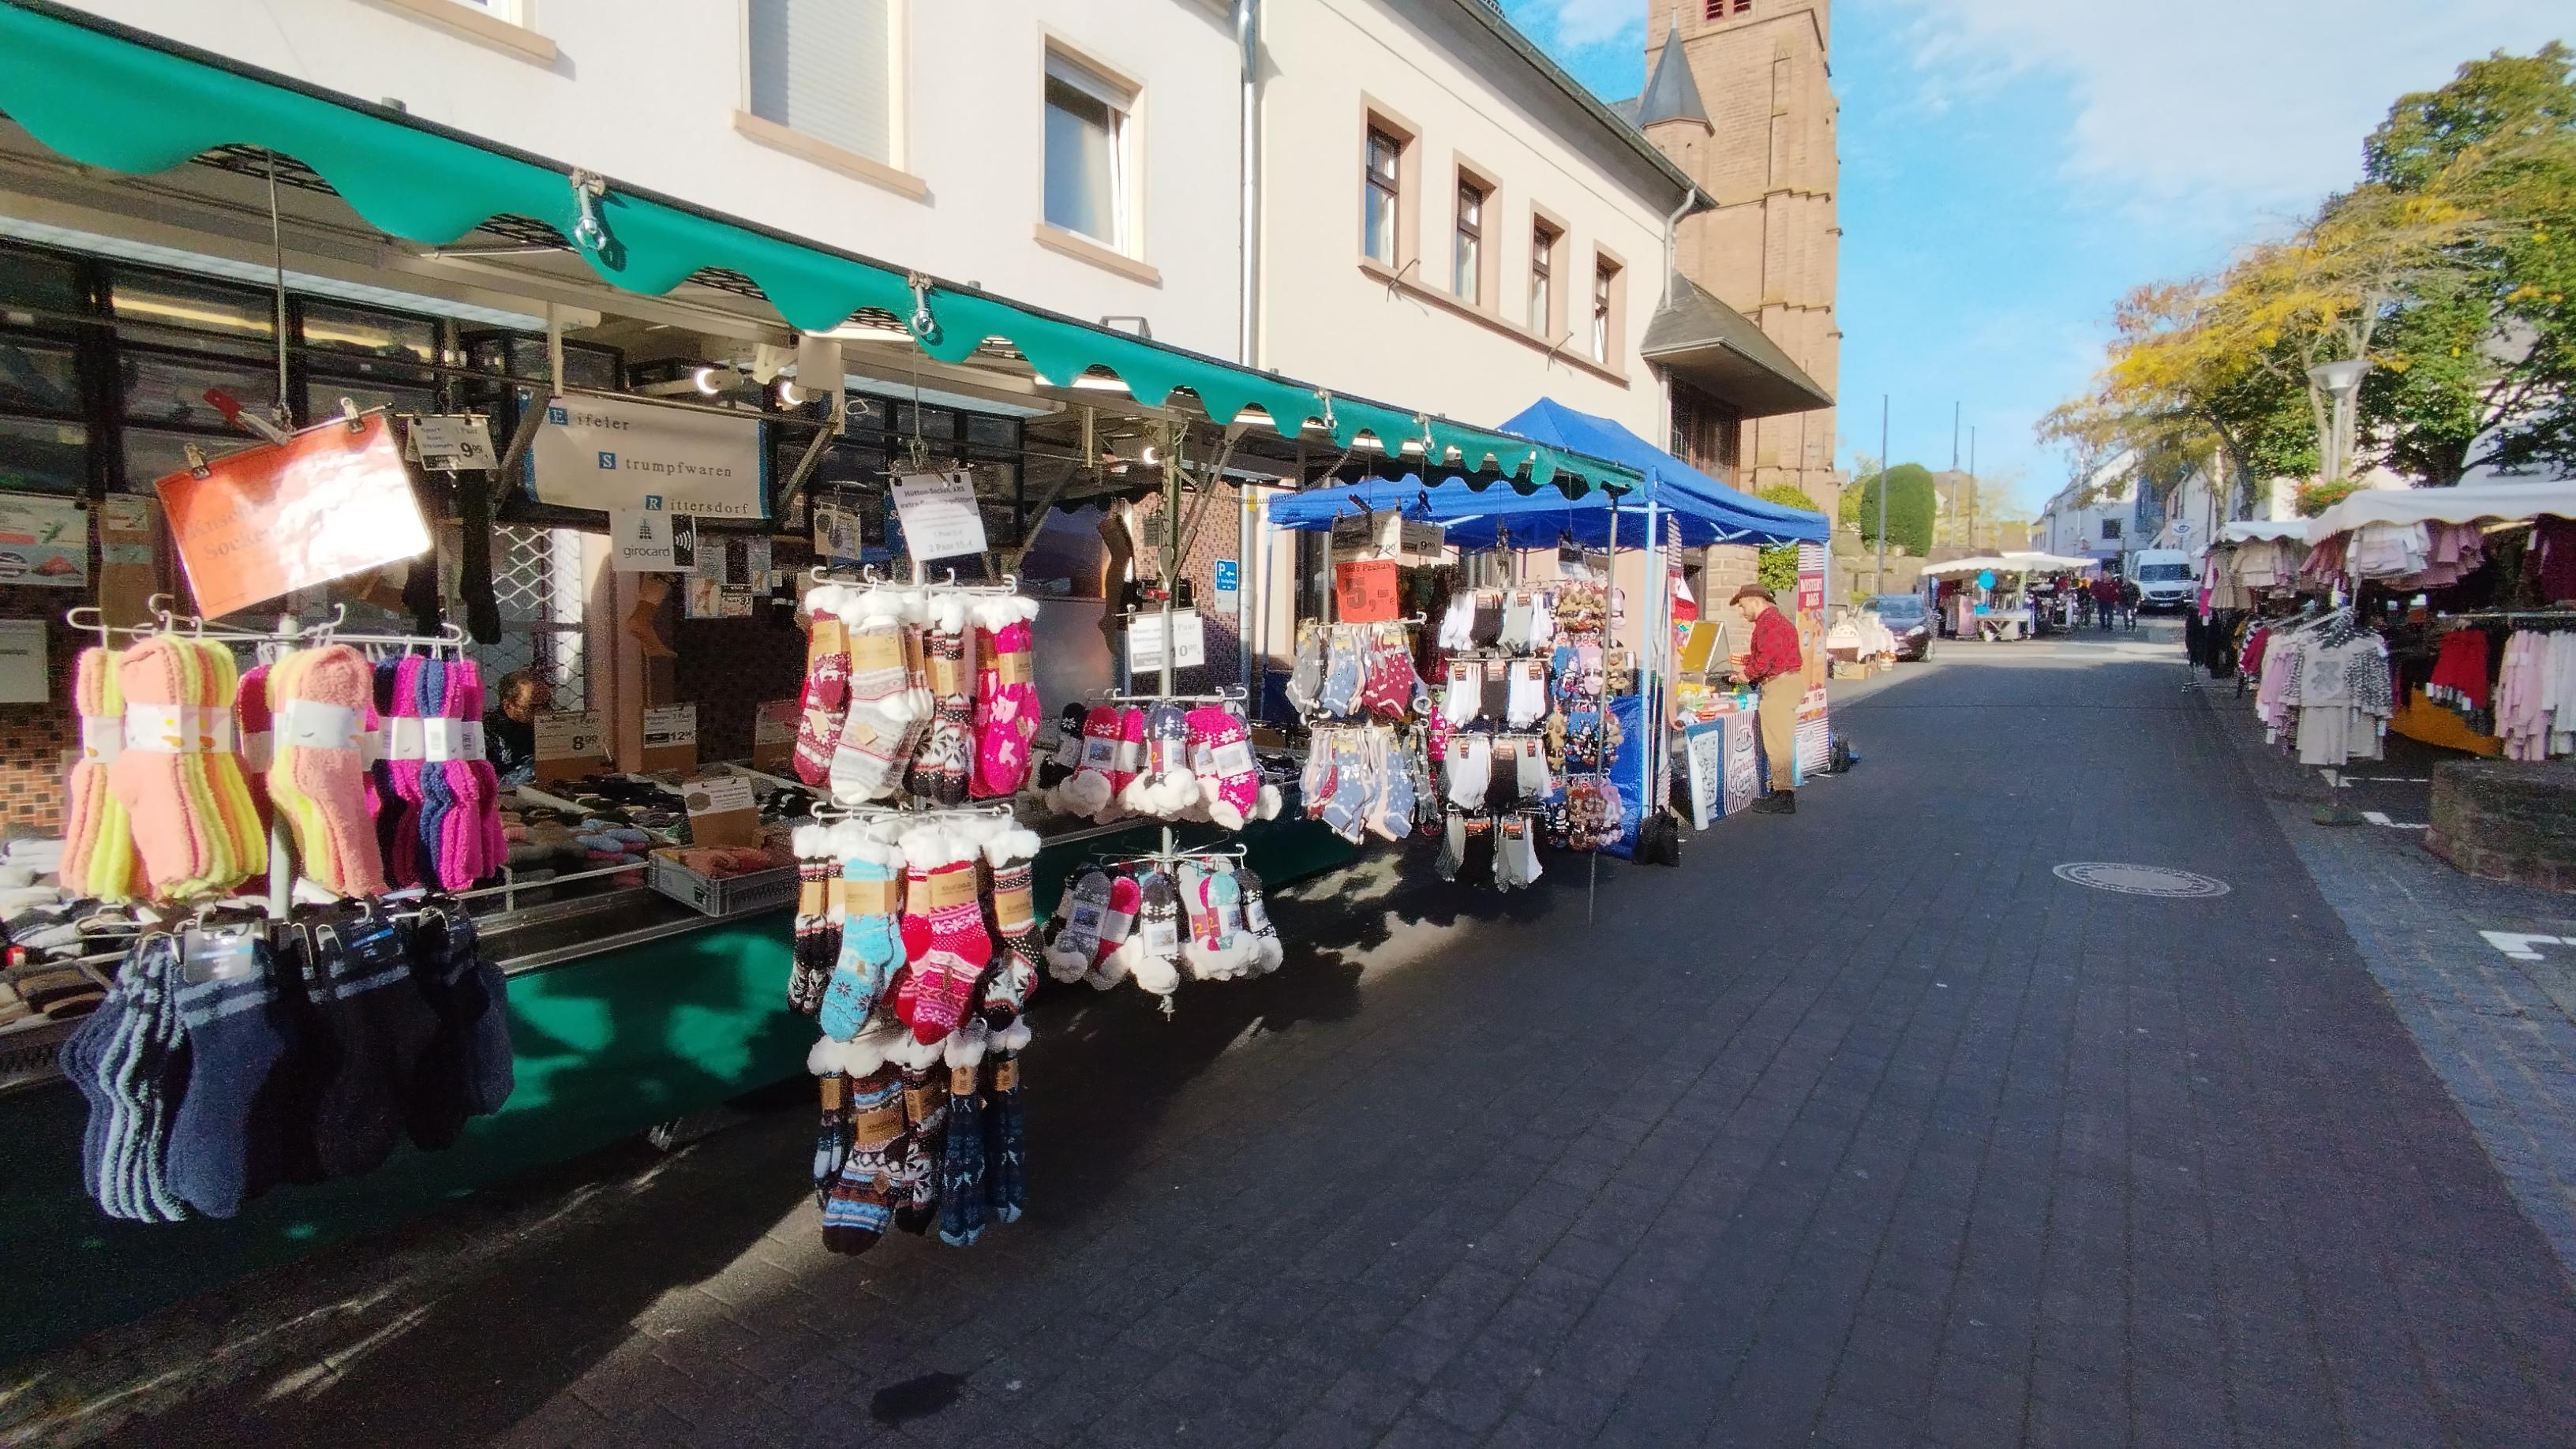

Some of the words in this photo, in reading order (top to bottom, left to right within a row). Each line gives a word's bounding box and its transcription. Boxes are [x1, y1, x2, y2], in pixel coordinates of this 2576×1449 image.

[623, 545, 671, 558] girocard
[1219, 563, 1226, 577] P
[1195, 923, 1203, 934] 2
